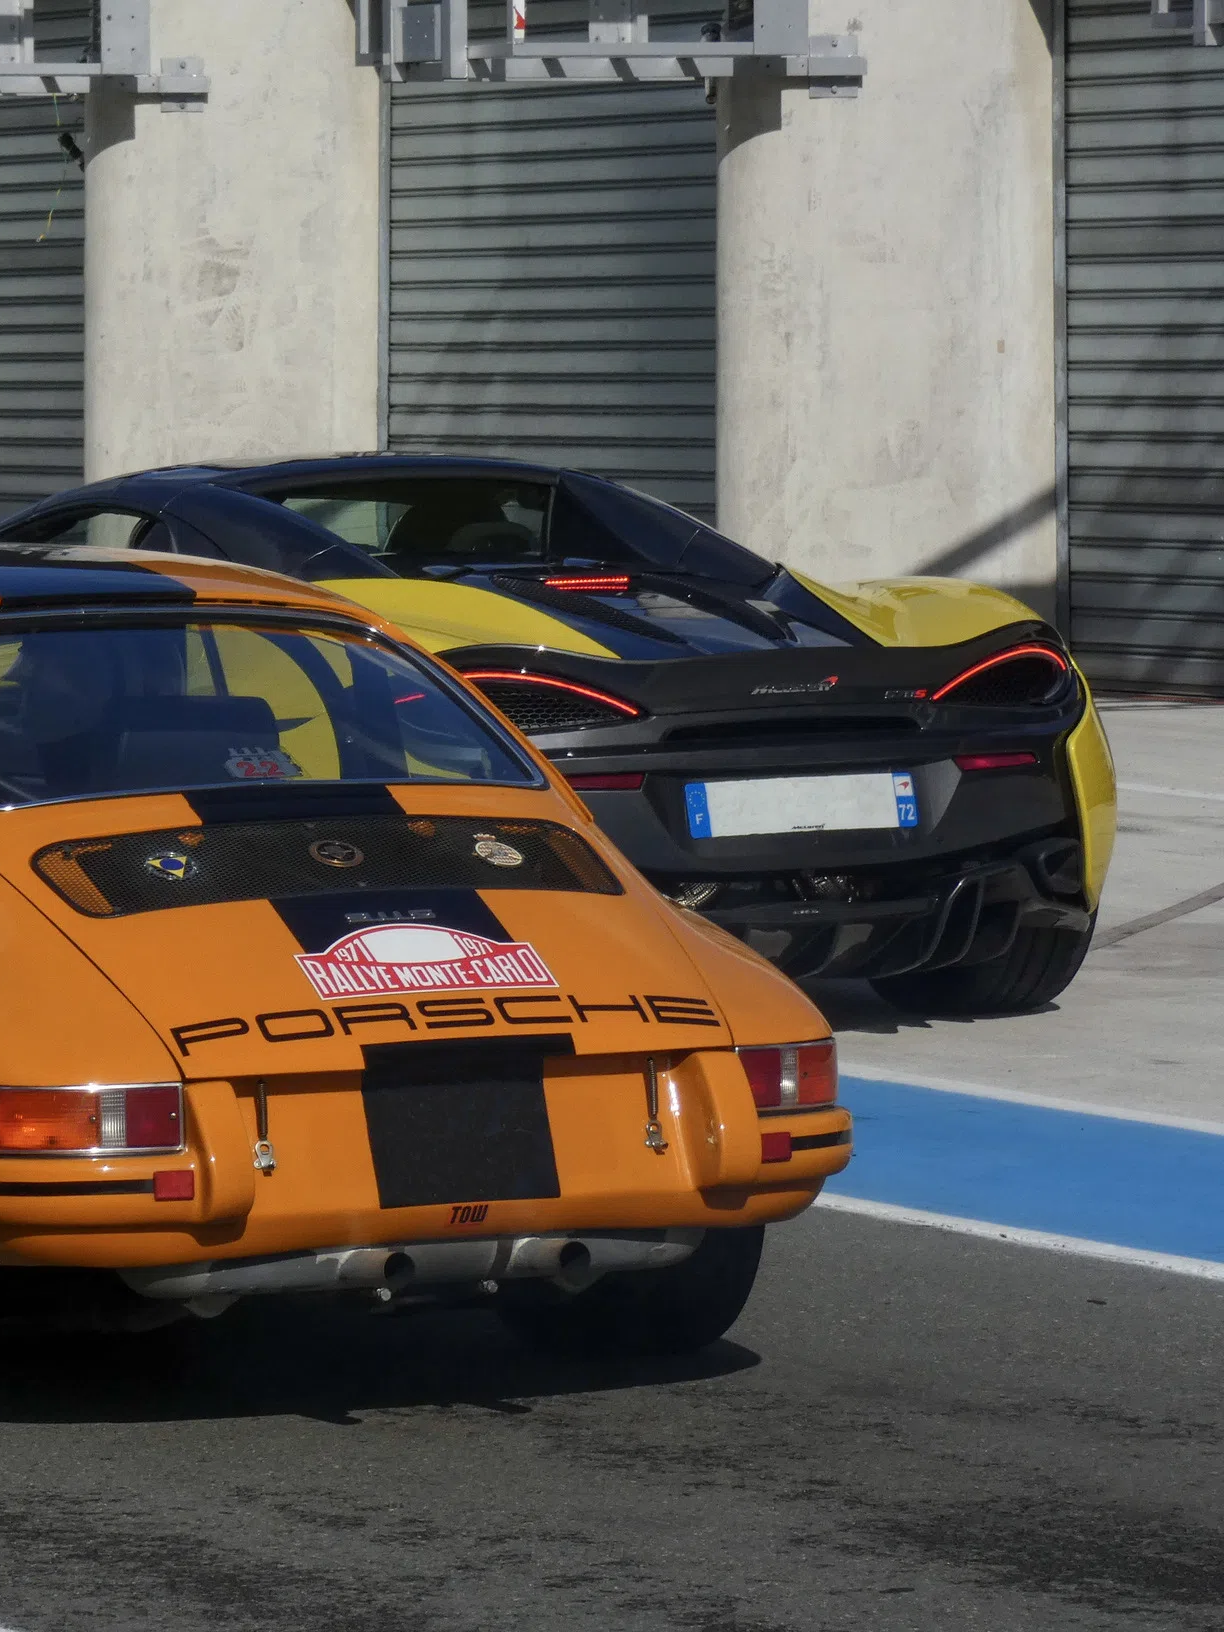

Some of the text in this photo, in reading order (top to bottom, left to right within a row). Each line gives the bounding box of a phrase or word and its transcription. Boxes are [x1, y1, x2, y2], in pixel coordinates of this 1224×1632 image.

[695, 813, 703, 825] F
[898, 803, 916, 821] 72
[334, 934, 494, 962] 1971 1971
[306, 948, 549, 995] RALLYE MONTE-CARLO
[170, 994, 721, 1056] PORSCHE
[449, 1205, 489, 1224] TOW
